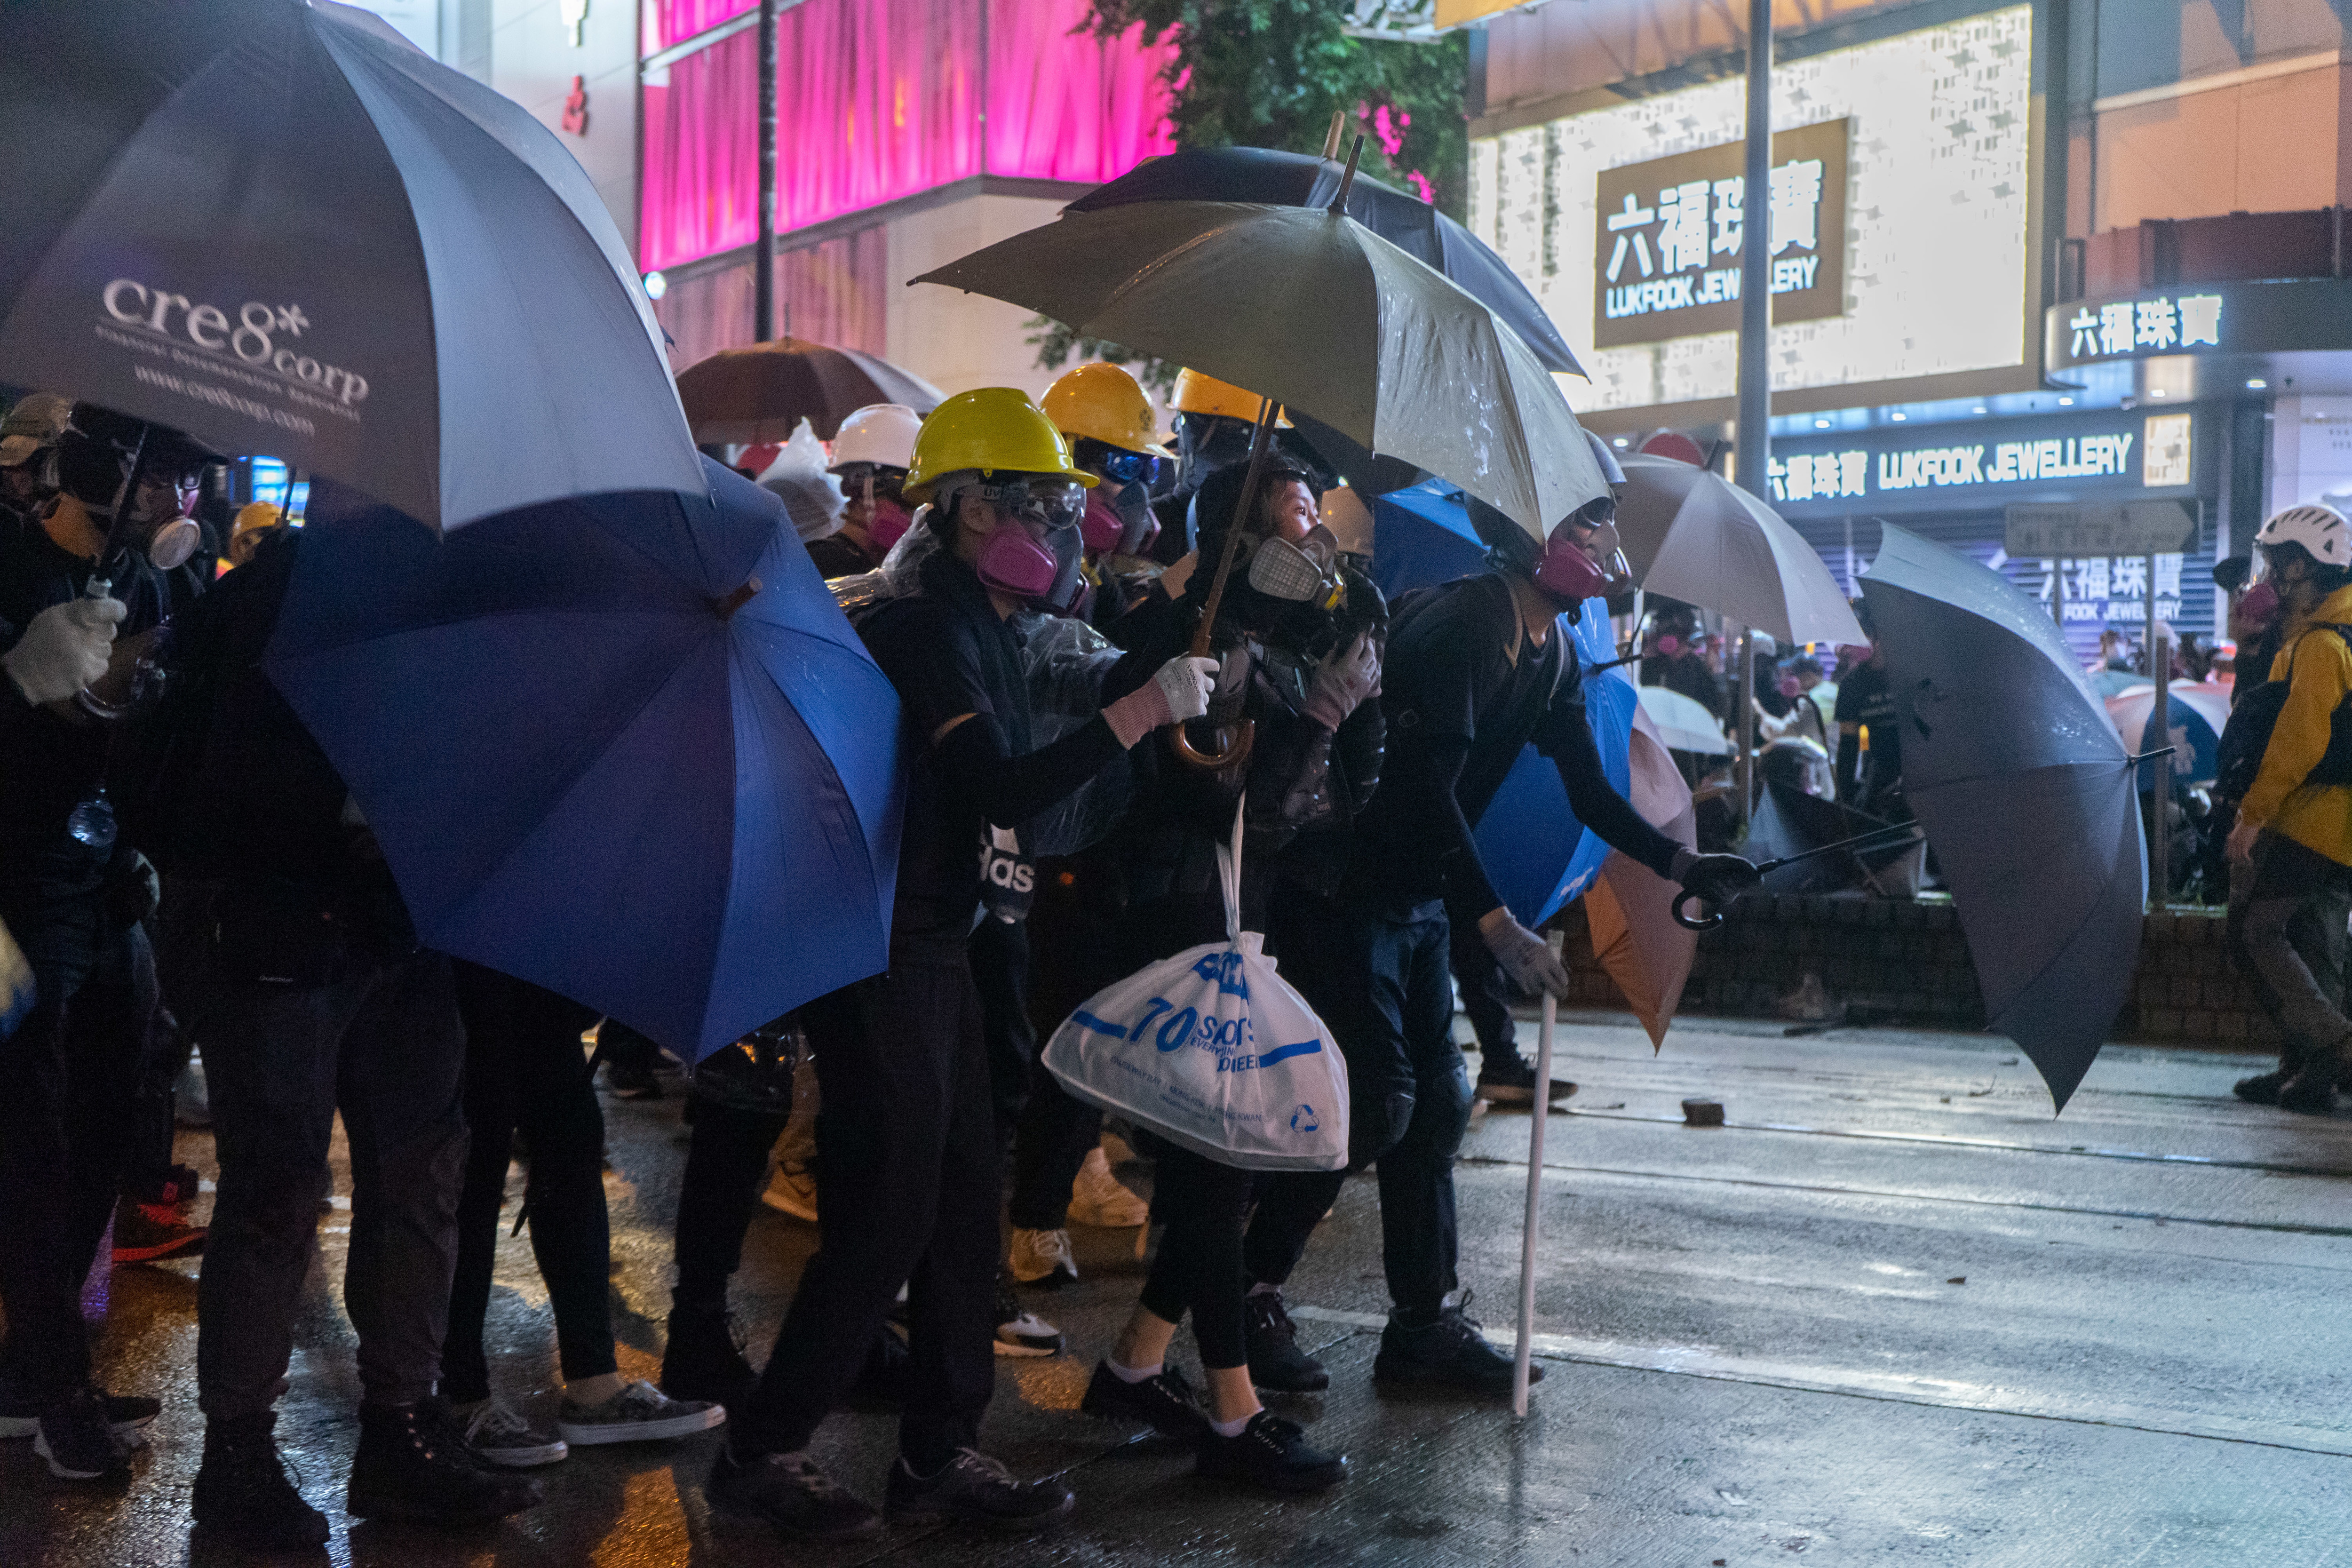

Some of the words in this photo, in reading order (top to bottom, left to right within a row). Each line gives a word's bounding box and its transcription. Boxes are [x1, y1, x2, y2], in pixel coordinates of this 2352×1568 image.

[1606, 275, 1695, 319] LUKFOOK
[1695, 255, 1819, 305] JEWERY
[2070, 294, 2222, 358] 六福珠寶
[274, 349, 369, 405] corp
[1878, 444, 1985, 490] LUKFOOK
[1986, 433, 2133, 482] JEWELLERY
[1129, 997, 1198, 1052] 70
